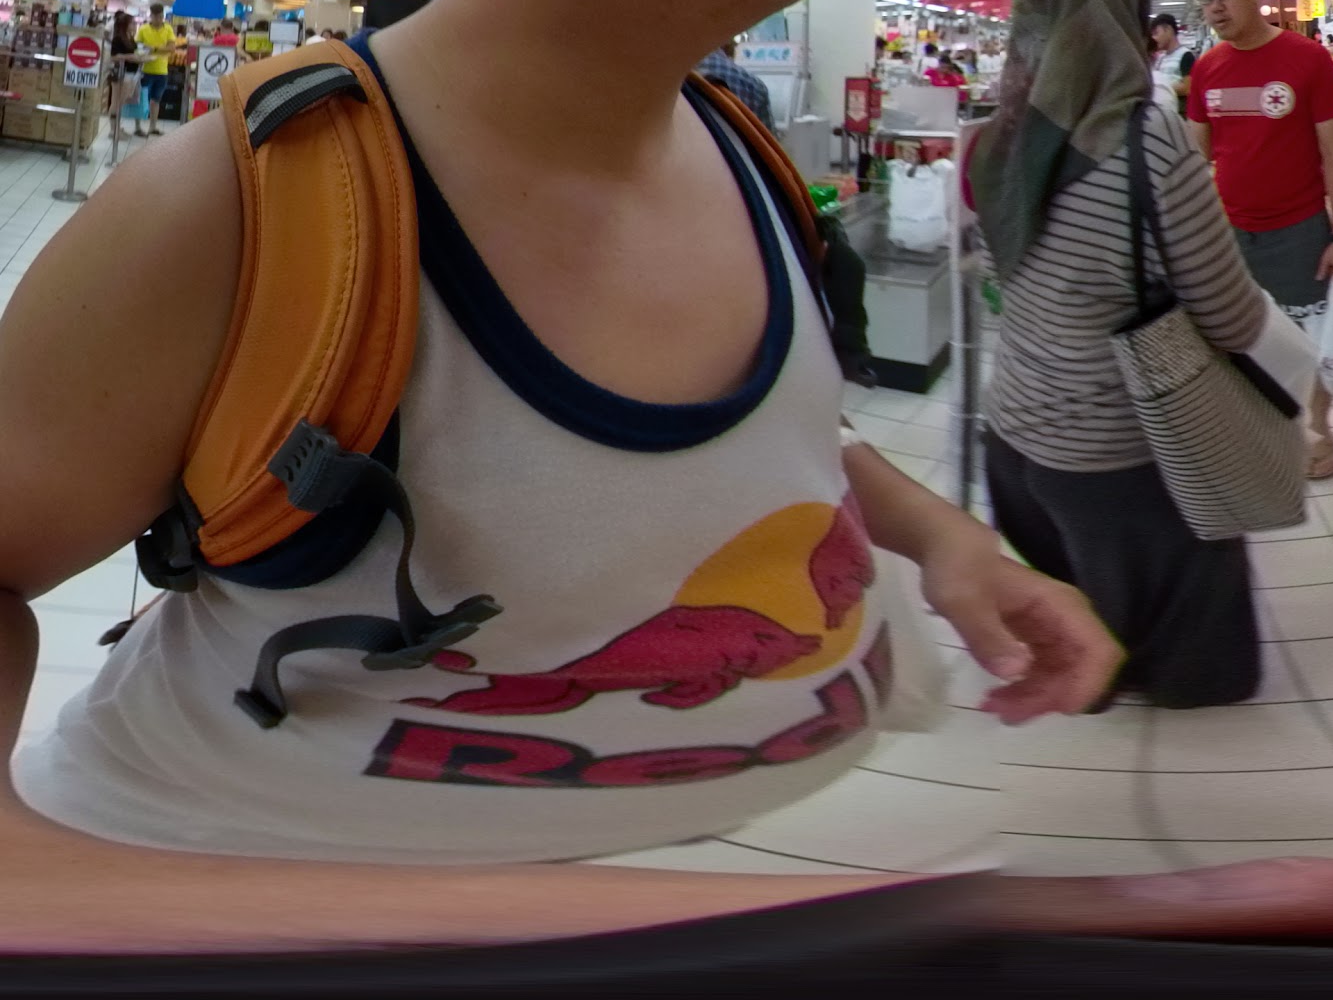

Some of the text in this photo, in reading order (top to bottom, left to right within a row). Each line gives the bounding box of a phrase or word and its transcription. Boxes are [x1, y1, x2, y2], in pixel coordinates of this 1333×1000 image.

[66, 70, 98, 86] NO ENTRY
[362, 669, 871, 788] Red
